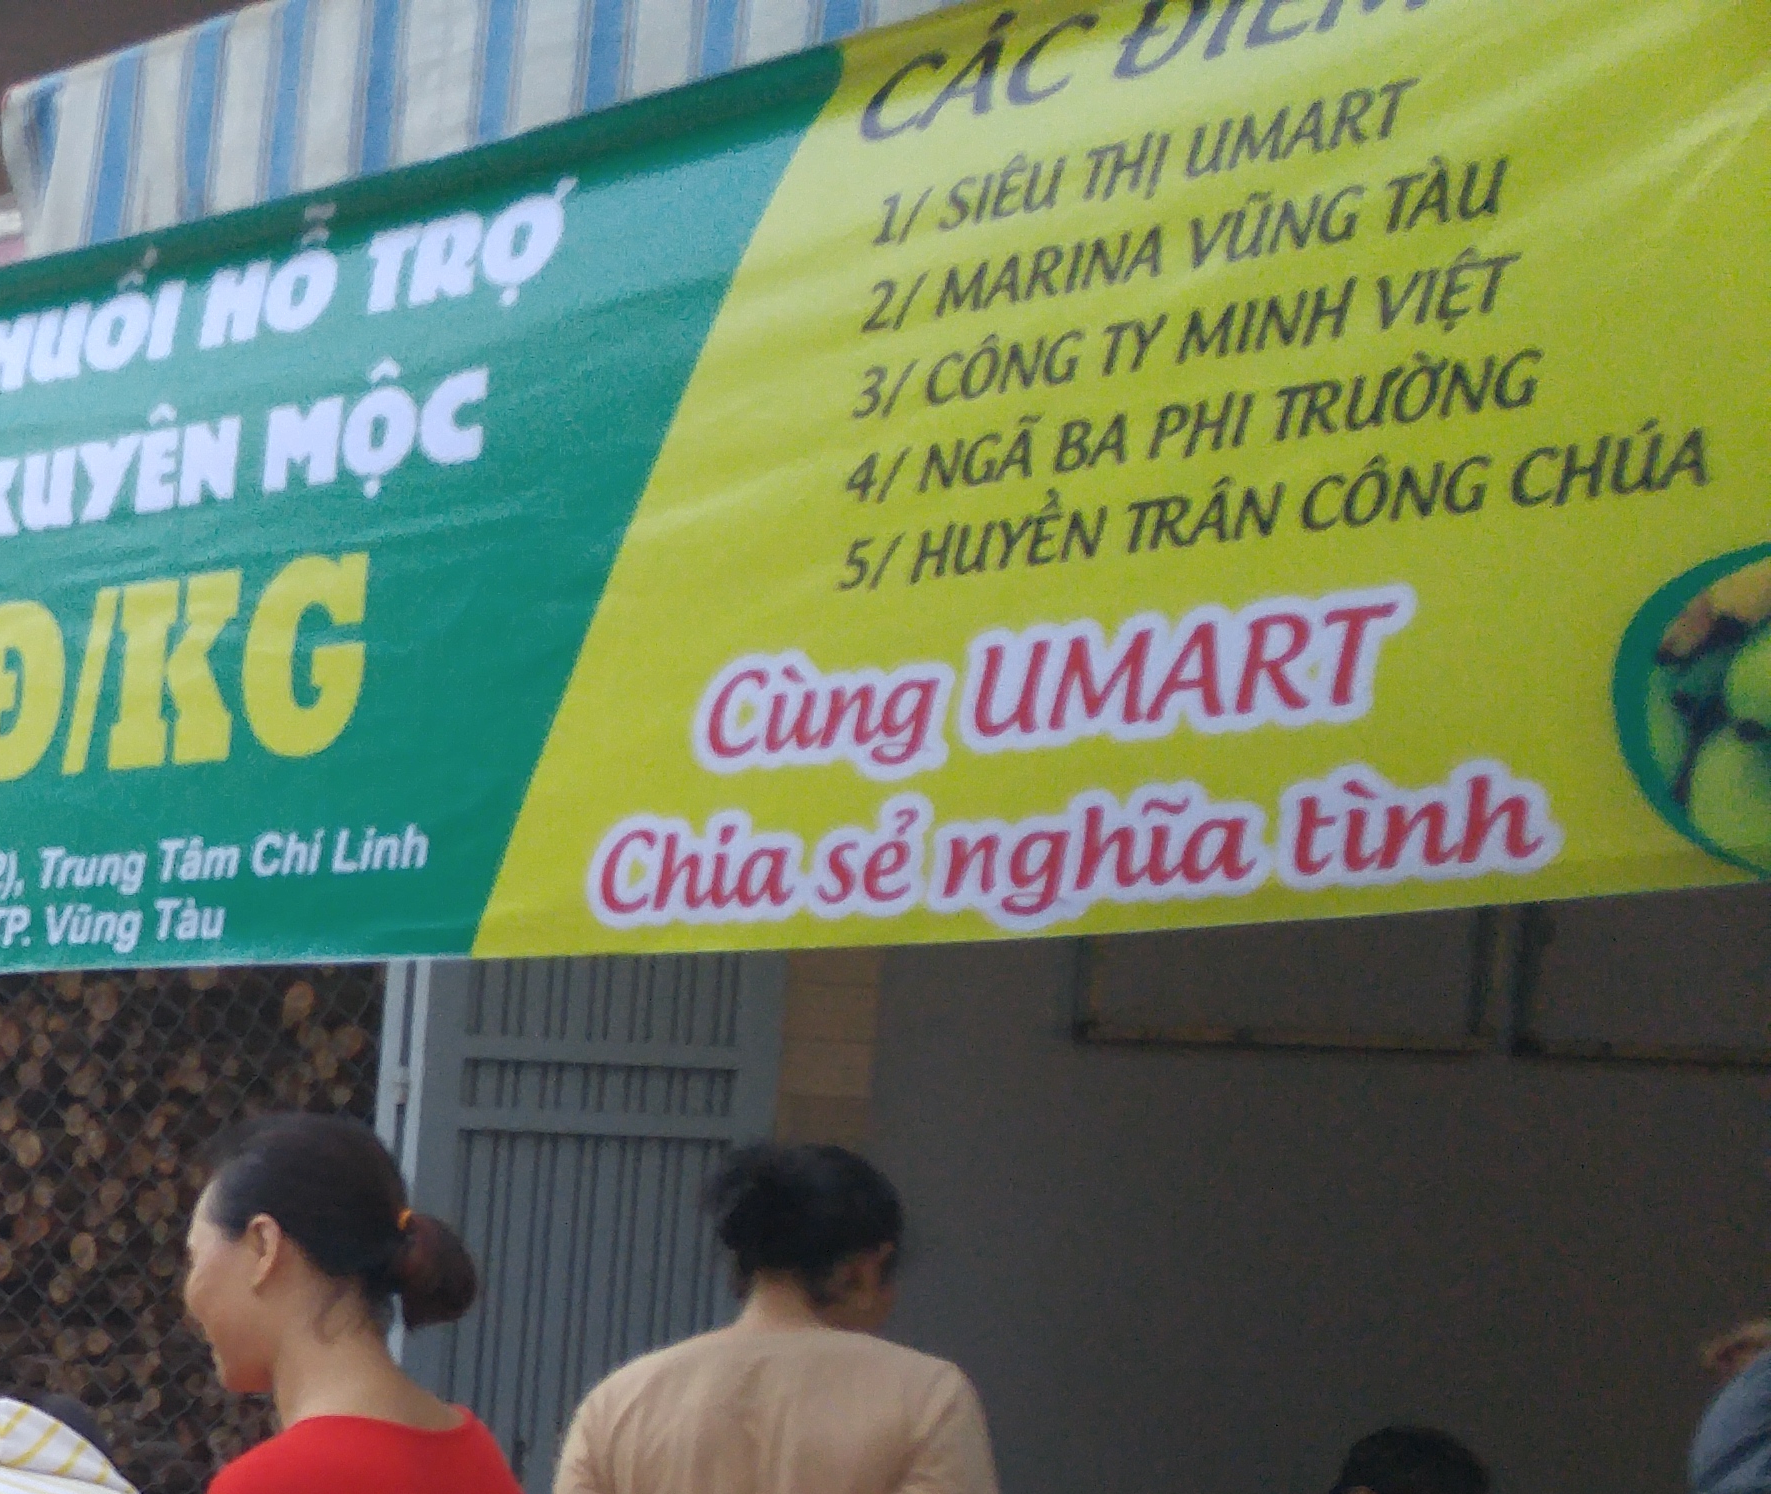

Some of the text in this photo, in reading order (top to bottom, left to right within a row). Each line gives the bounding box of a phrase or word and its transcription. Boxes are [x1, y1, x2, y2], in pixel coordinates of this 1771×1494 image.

[859, 9, 1101, 142] CÁC
[872, 76, 1422, 247] 1/ SIÊU THỊ UMART
[198, 201, 340, 352] HỖ
[365, 176, 579, 316] TRỢ
[860, 154, 1511, 334] 2/ MARINA VŨNG TÀU
[851, 244, 1524, 420] 3/ CÔNG TY MINH VIỆT
[260, 356, 491, 500] MỘC
[836, 531, 907, 592] 5/
[1125, 475, 1288, 556] TRÂN
[1300, 453, 1494, 534] CÔNG
[1508, 417, 1712, 509] CHÚA
[845, 347, 1545, 504] 4/ NGÃ BA PHI TRƯỜNG
[705, 600, 1401, 767] Cùng UMART
[38, 844, 148, 898] Trung
[158, 836, 242, 884] Tâm
[251, 826, 327, 879] Chí
[330, 822, 432, 876] Linh
[44, 901, 145, 954] Vũng
[153, 896, 227, 942] Tàu
[598, 773, 1546, 917] Chia sẻ nghĩa tình
